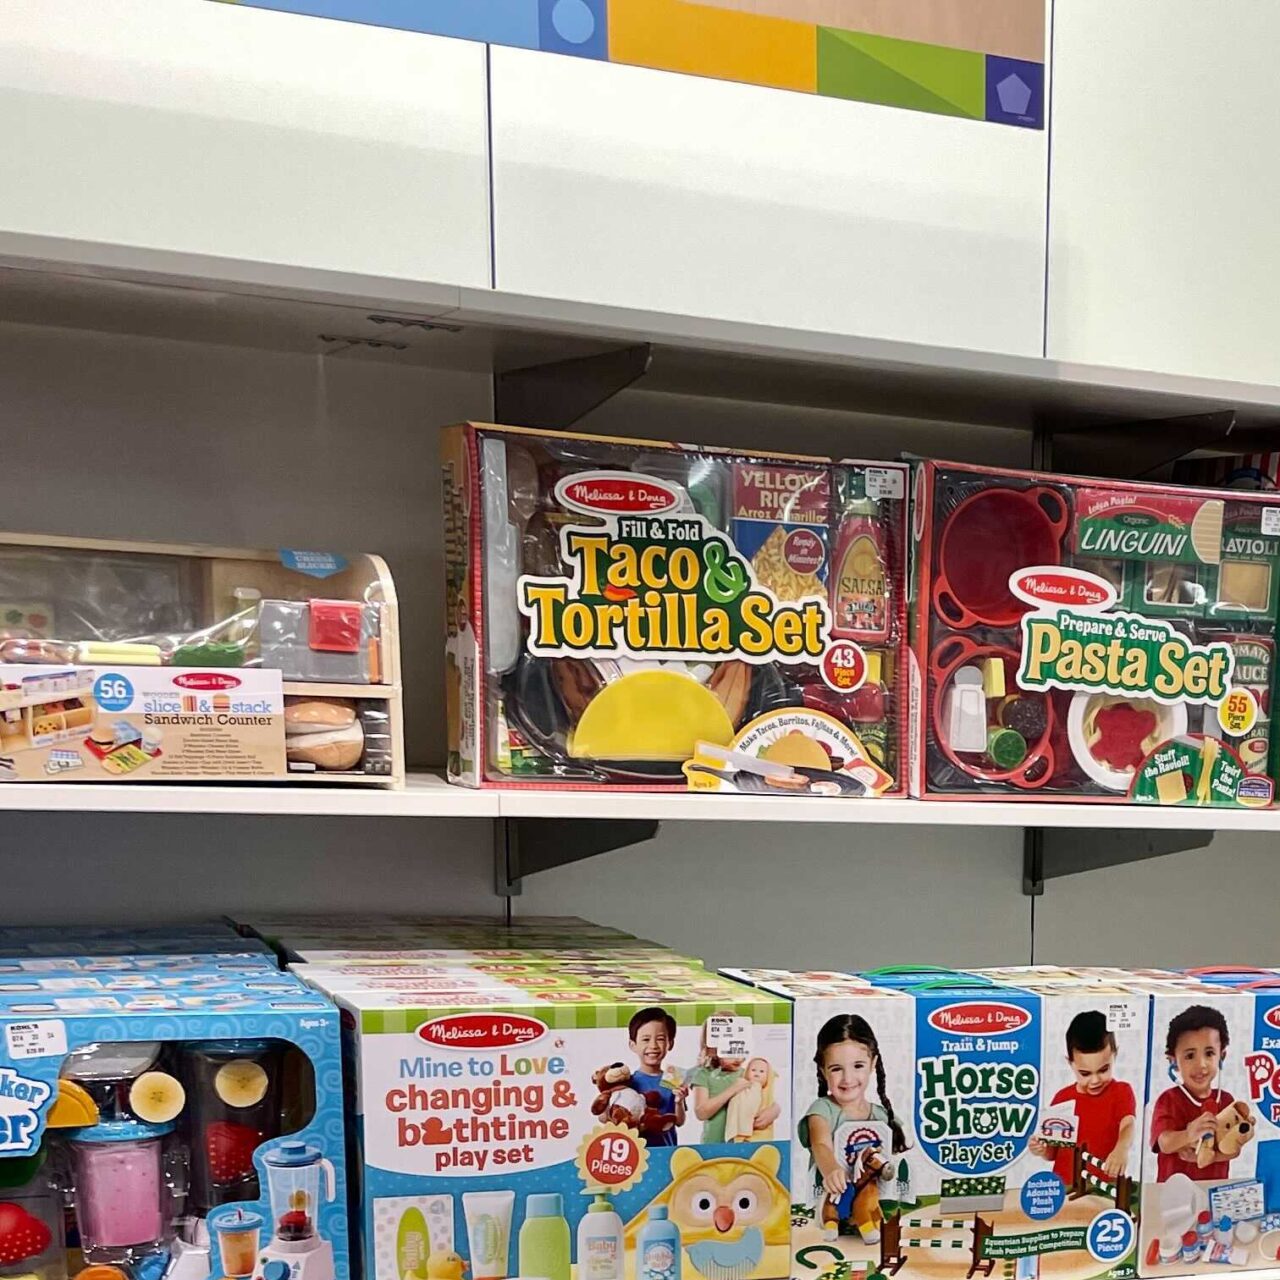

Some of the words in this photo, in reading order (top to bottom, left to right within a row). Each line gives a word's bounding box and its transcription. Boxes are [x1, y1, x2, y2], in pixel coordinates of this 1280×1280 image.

[741, 470, 817, 493] YELLOW
[573, 484, 625, 503] Melissa
[637, 489, 670, 509] Doug
[621, 519, 647, 539] Fill
[667, 522, 701, 542] Fold
[1122, 515, 1151, 526] Organic
[1080, 527, 1189, 557] LINGUINI
[569, 535, 701, 596] Taco
[702, 541, 749, 603] &
[1025, 574, 1068, 596] Melissa
[1079, 585, 1105, 604] Doug
[525, 586, 733, 651] Tortilla
[740, 595, 823, 655] Set
[1060, 615, 1114, 638] Prepare
[1129, 624, 1168, 643] Serve
[831, 649, 854, 668] 43
[1026, 623, 1149, 688] Pasta
[1154, 641, 1227, 697] Set
[99, 680, 127, 699] 56
[144, 699, 182, 713] slice
[232, 700, 272, 714] stack
[1228, 695, 1248, 713] 55
[144, 713, 214, 726] Sandwich
[217, 714, 273, 726] Counter
[428, 1023, 488, 1041] Melissa
[501, 1021, 538, 1042] Doug
[940, 1012, 985, 1026] Melissa
[995, 1012, 1022, 1028] Doug
[941, 1038, 974, 1053] Train
[986, 1039, 1019, 1055] Jump
[400, 1056, 464, 1079] Mine
[468, 1057, 494, 1077] to
[500, 1053, 566, 1077] Love
[921, 1060, 1036, 1099] Horse
[385, 1081, 544, 1120] changing
[551, 1082, 578, 1107] &
[922, 1099, 1032, 1140] Show
[435, 1147, 489, 1172] play
[493, 1145, 534, 1164] set
[599, 1138, 630, 1162] 19
[940, 1144, 980, 1166] Play
[981, 1141, 1013, 1161] Set
[591, 1159, 633, 1178] Pieces
[1026, 1188, 1061, 1197] Adorable
[1096, 1218, 1125, 1244] 25
